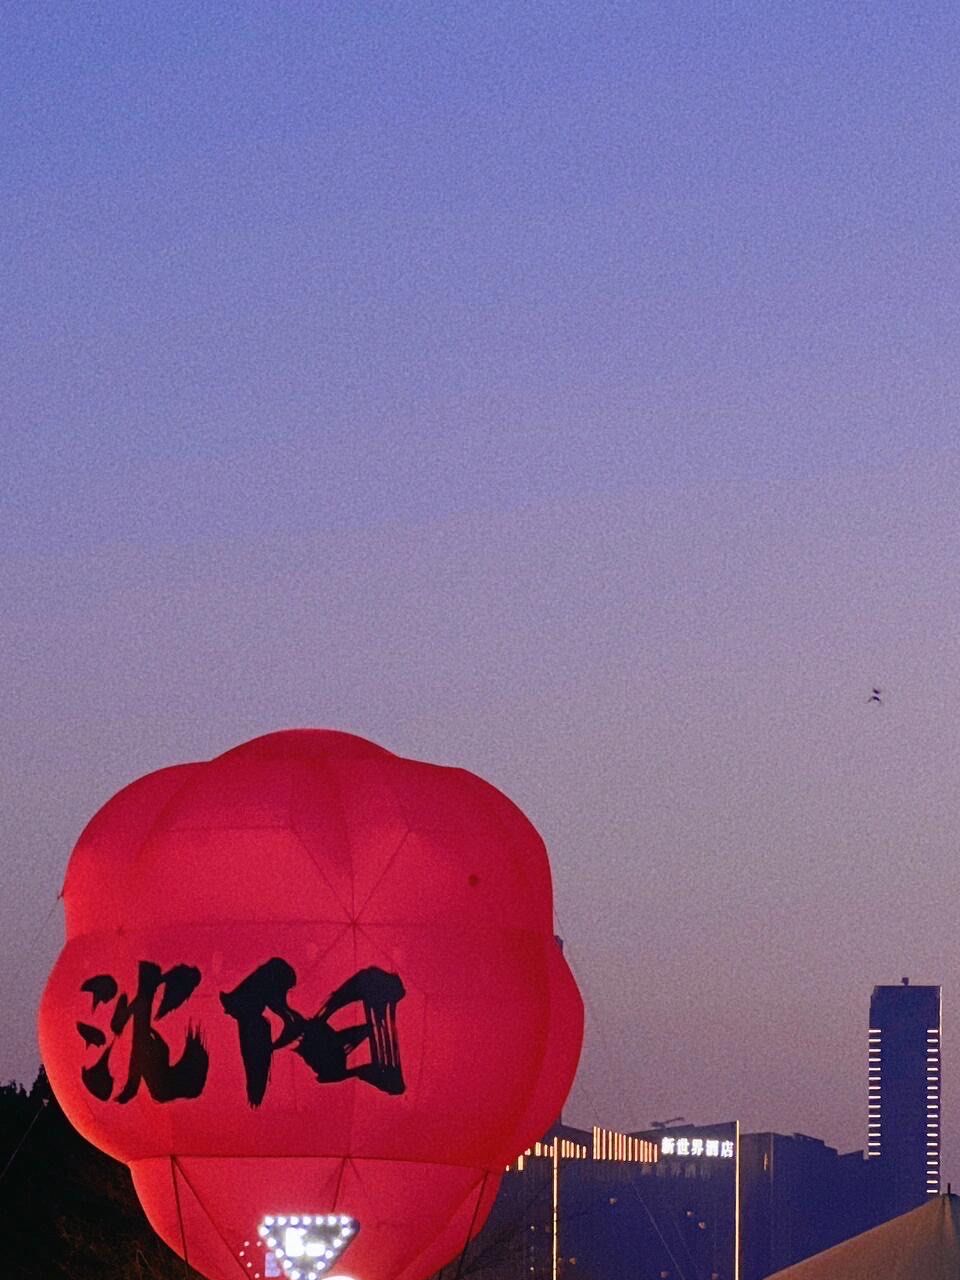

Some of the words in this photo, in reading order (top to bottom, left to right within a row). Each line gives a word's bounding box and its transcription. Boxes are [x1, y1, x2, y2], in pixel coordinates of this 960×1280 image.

[76, 957, 406, 1109] 沈阳
[661, 1137, 734, 1157] 新世界酒店
